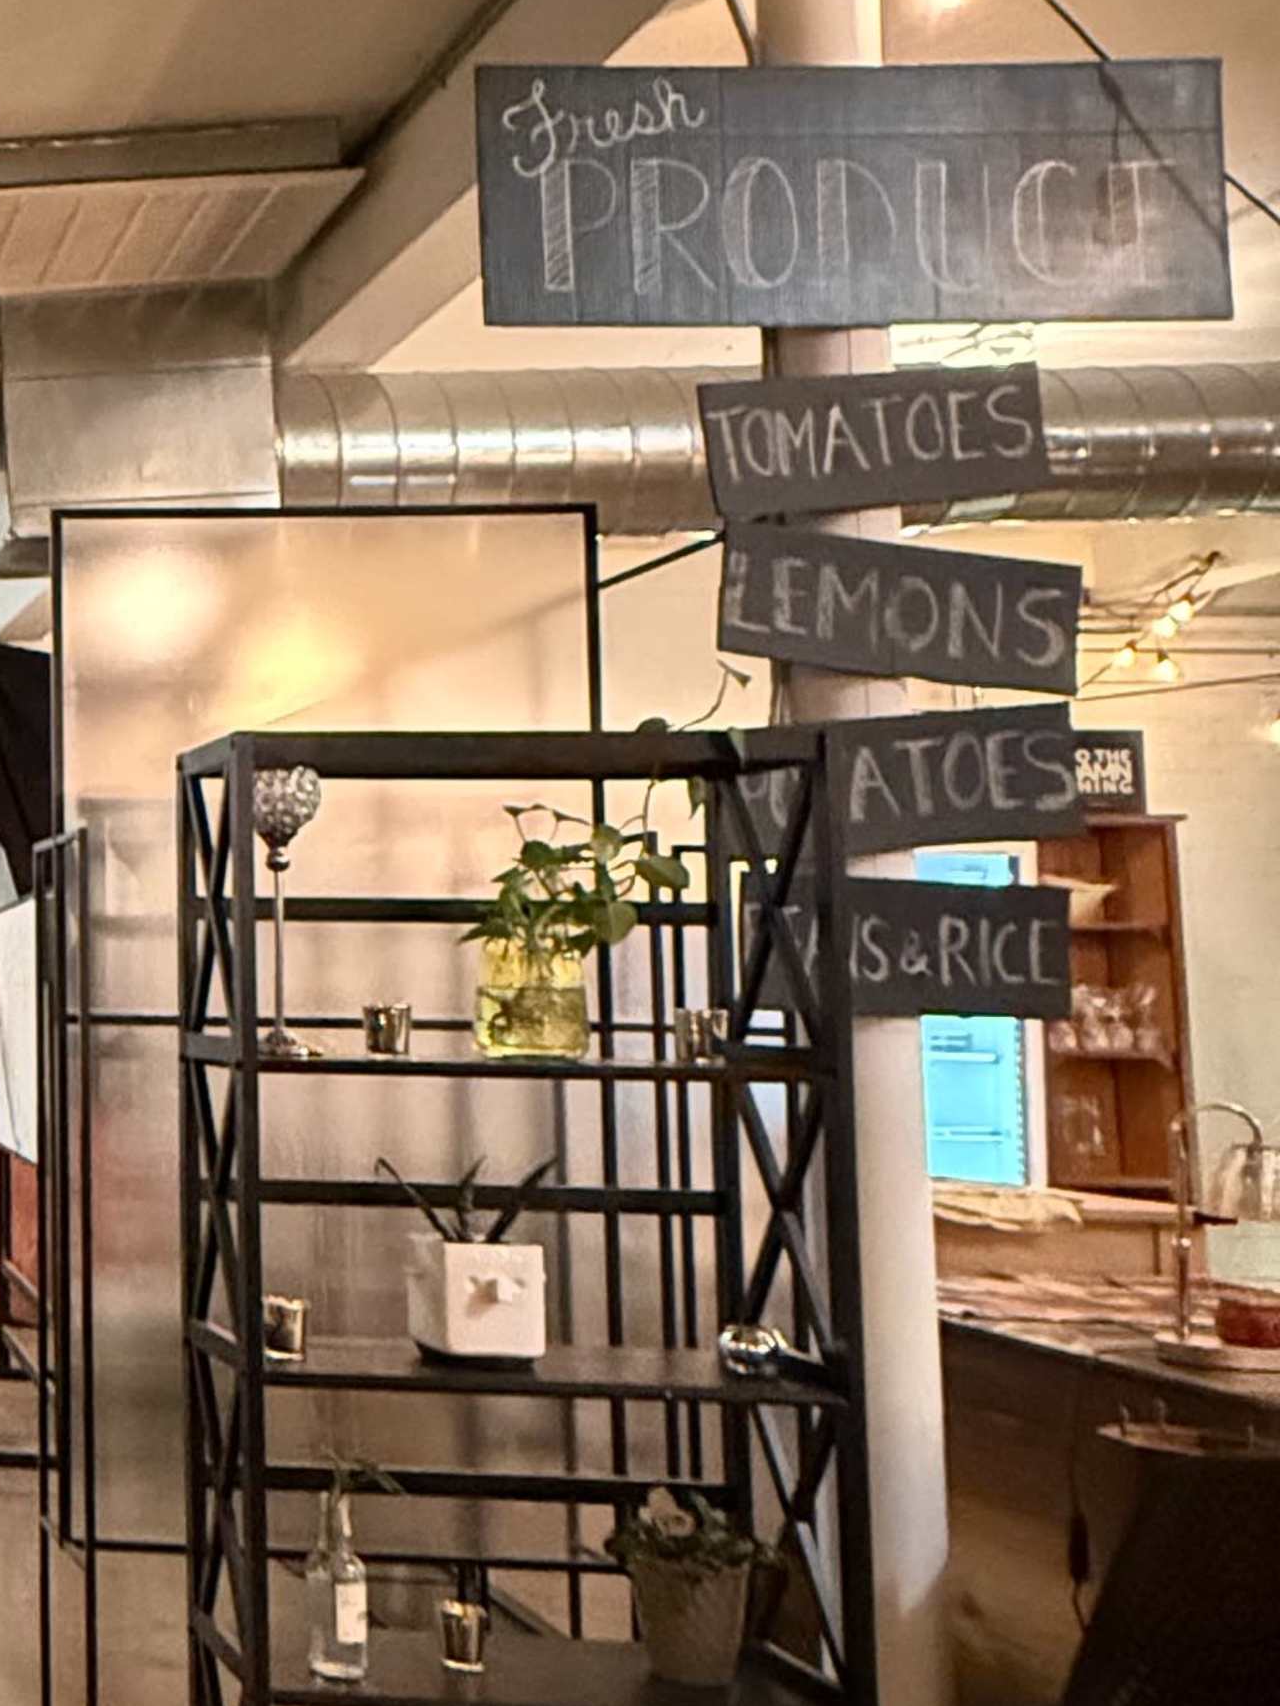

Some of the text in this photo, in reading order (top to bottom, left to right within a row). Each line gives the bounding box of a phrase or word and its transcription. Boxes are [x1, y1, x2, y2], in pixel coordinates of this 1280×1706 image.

[502, 78, 706, 177] Fresh
[706, 383, 1036, 485] TOMATOES
[723, 551, 1067, 669] LEMONS
[737, 729, 1078, 829] ATOES
[1075, 760, 1133, 781] AMN
[1077, 777, 1136, 795] HING
[938, 911, 1063, 988] RICE
